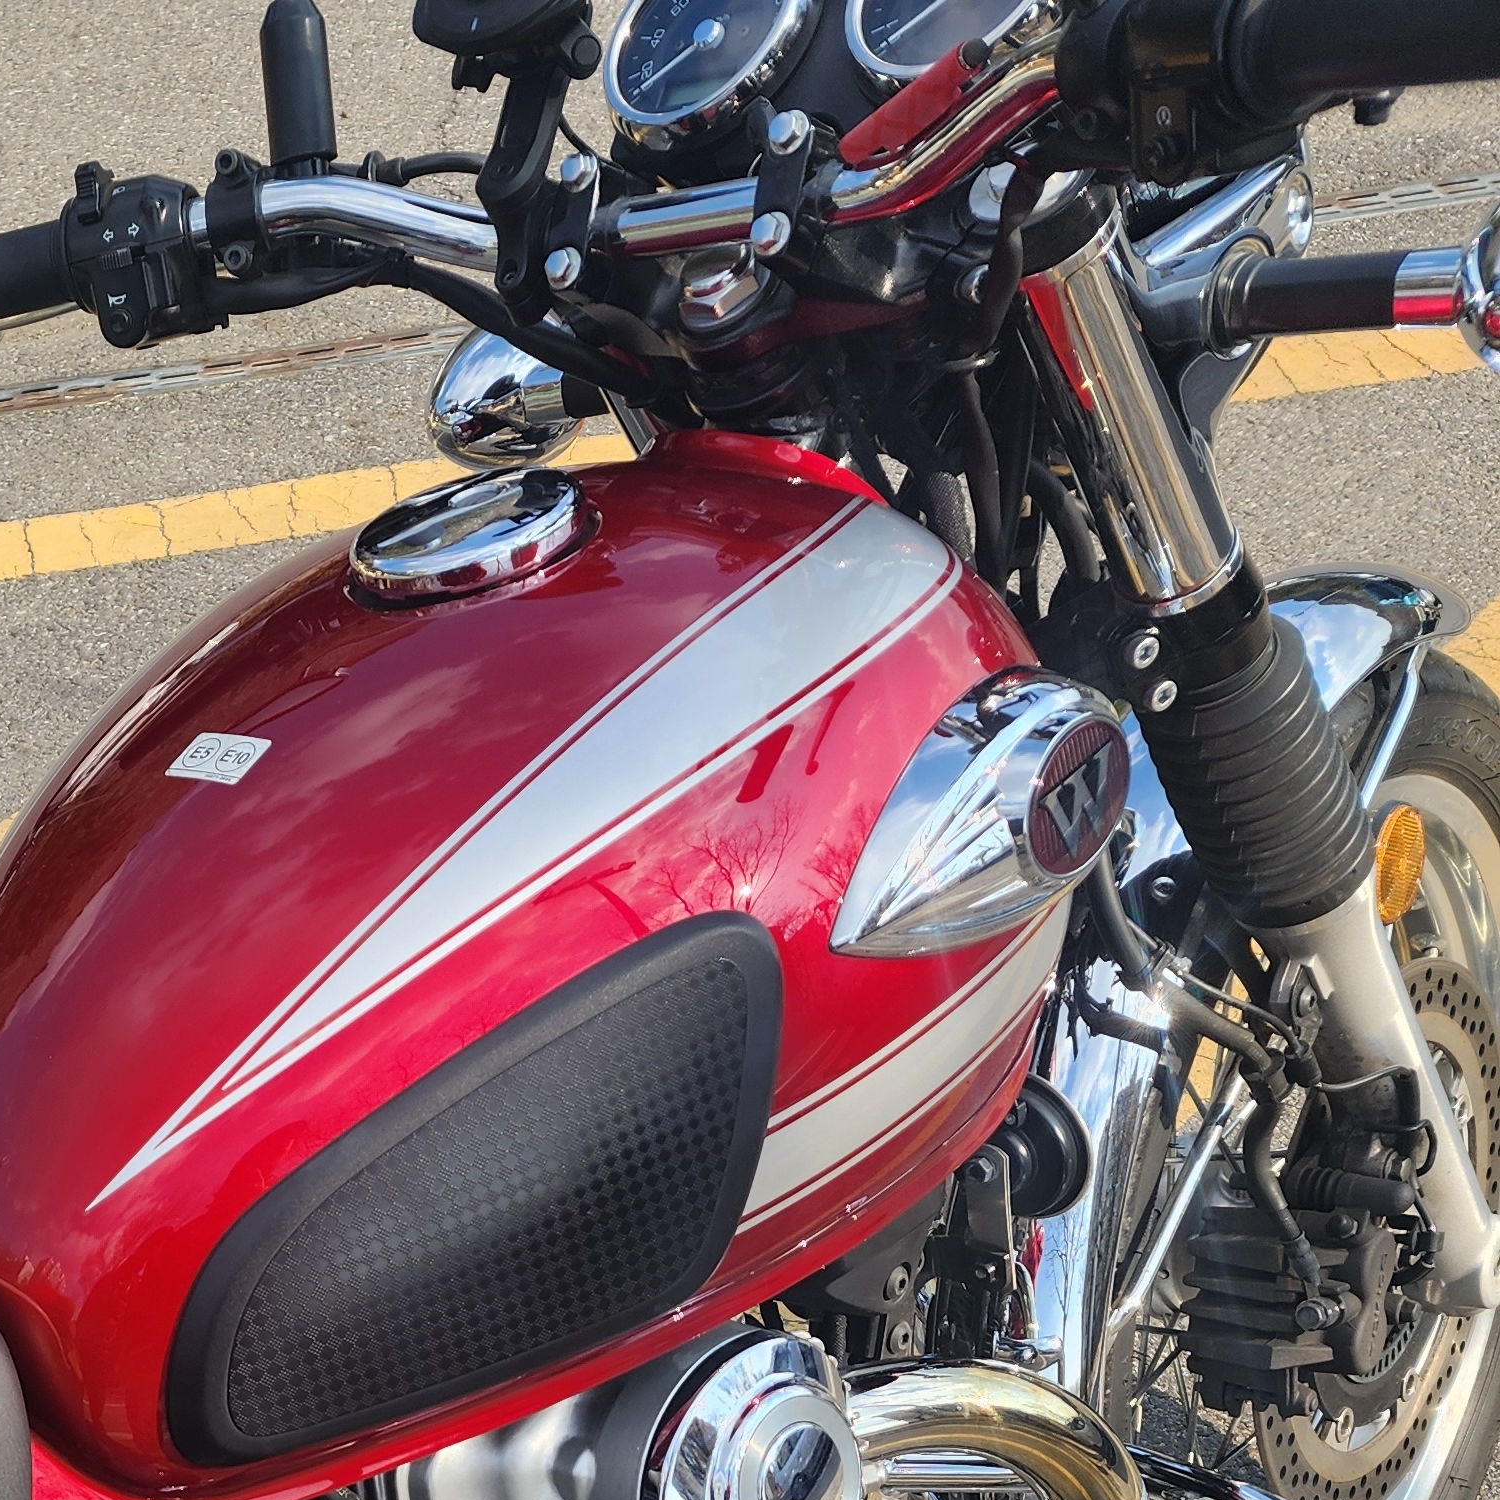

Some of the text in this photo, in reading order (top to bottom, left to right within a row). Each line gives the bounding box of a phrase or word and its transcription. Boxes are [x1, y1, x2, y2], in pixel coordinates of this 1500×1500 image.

[651, 28, 666, 49] 40
[640, 60, 653, 80] 20
[190, 746, 251, 765] E5 E10
[1038, 739, 1114, 861] W
